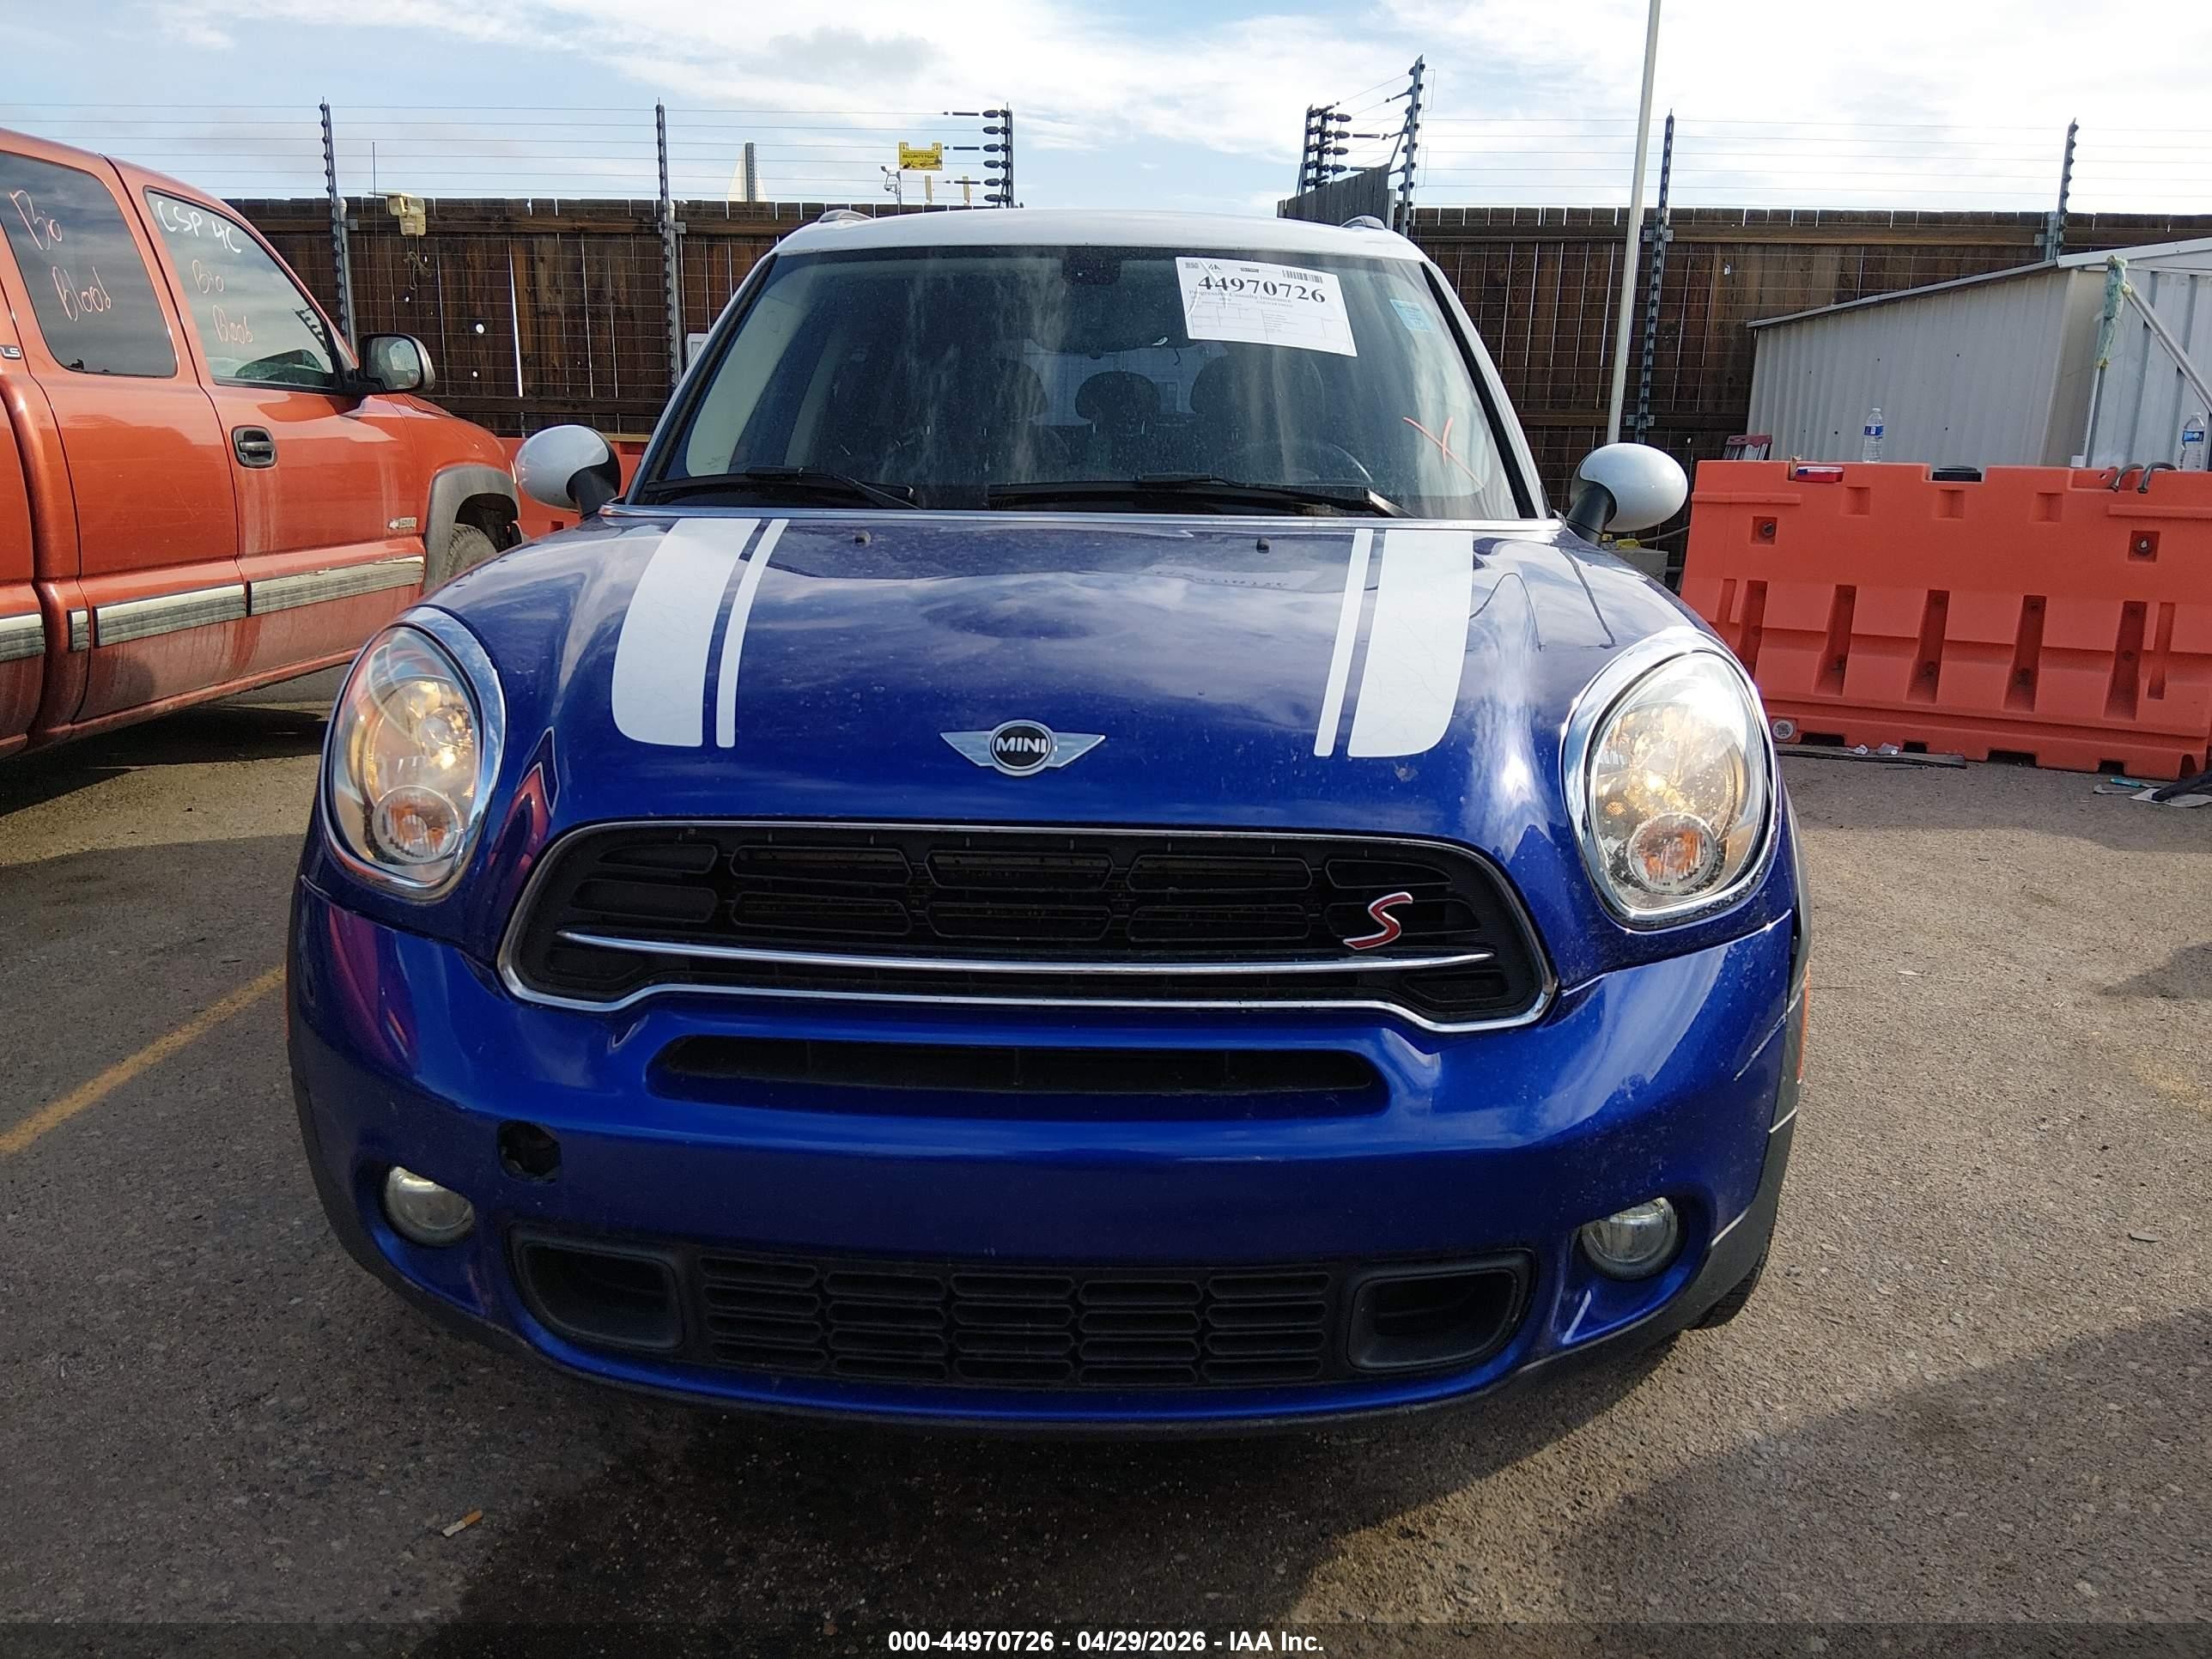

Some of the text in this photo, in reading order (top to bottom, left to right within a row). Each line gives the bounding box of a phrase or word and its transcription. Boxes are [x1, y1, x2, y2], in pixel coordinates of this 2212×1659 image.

[157, 201, 203, 238] CSP
[52, 265, 112, 322] Blood
[1198, 276, 1326, 303] 44970726
[995, 737, 1047, 753] MINI
[1342, 891, 1413, 951] S
